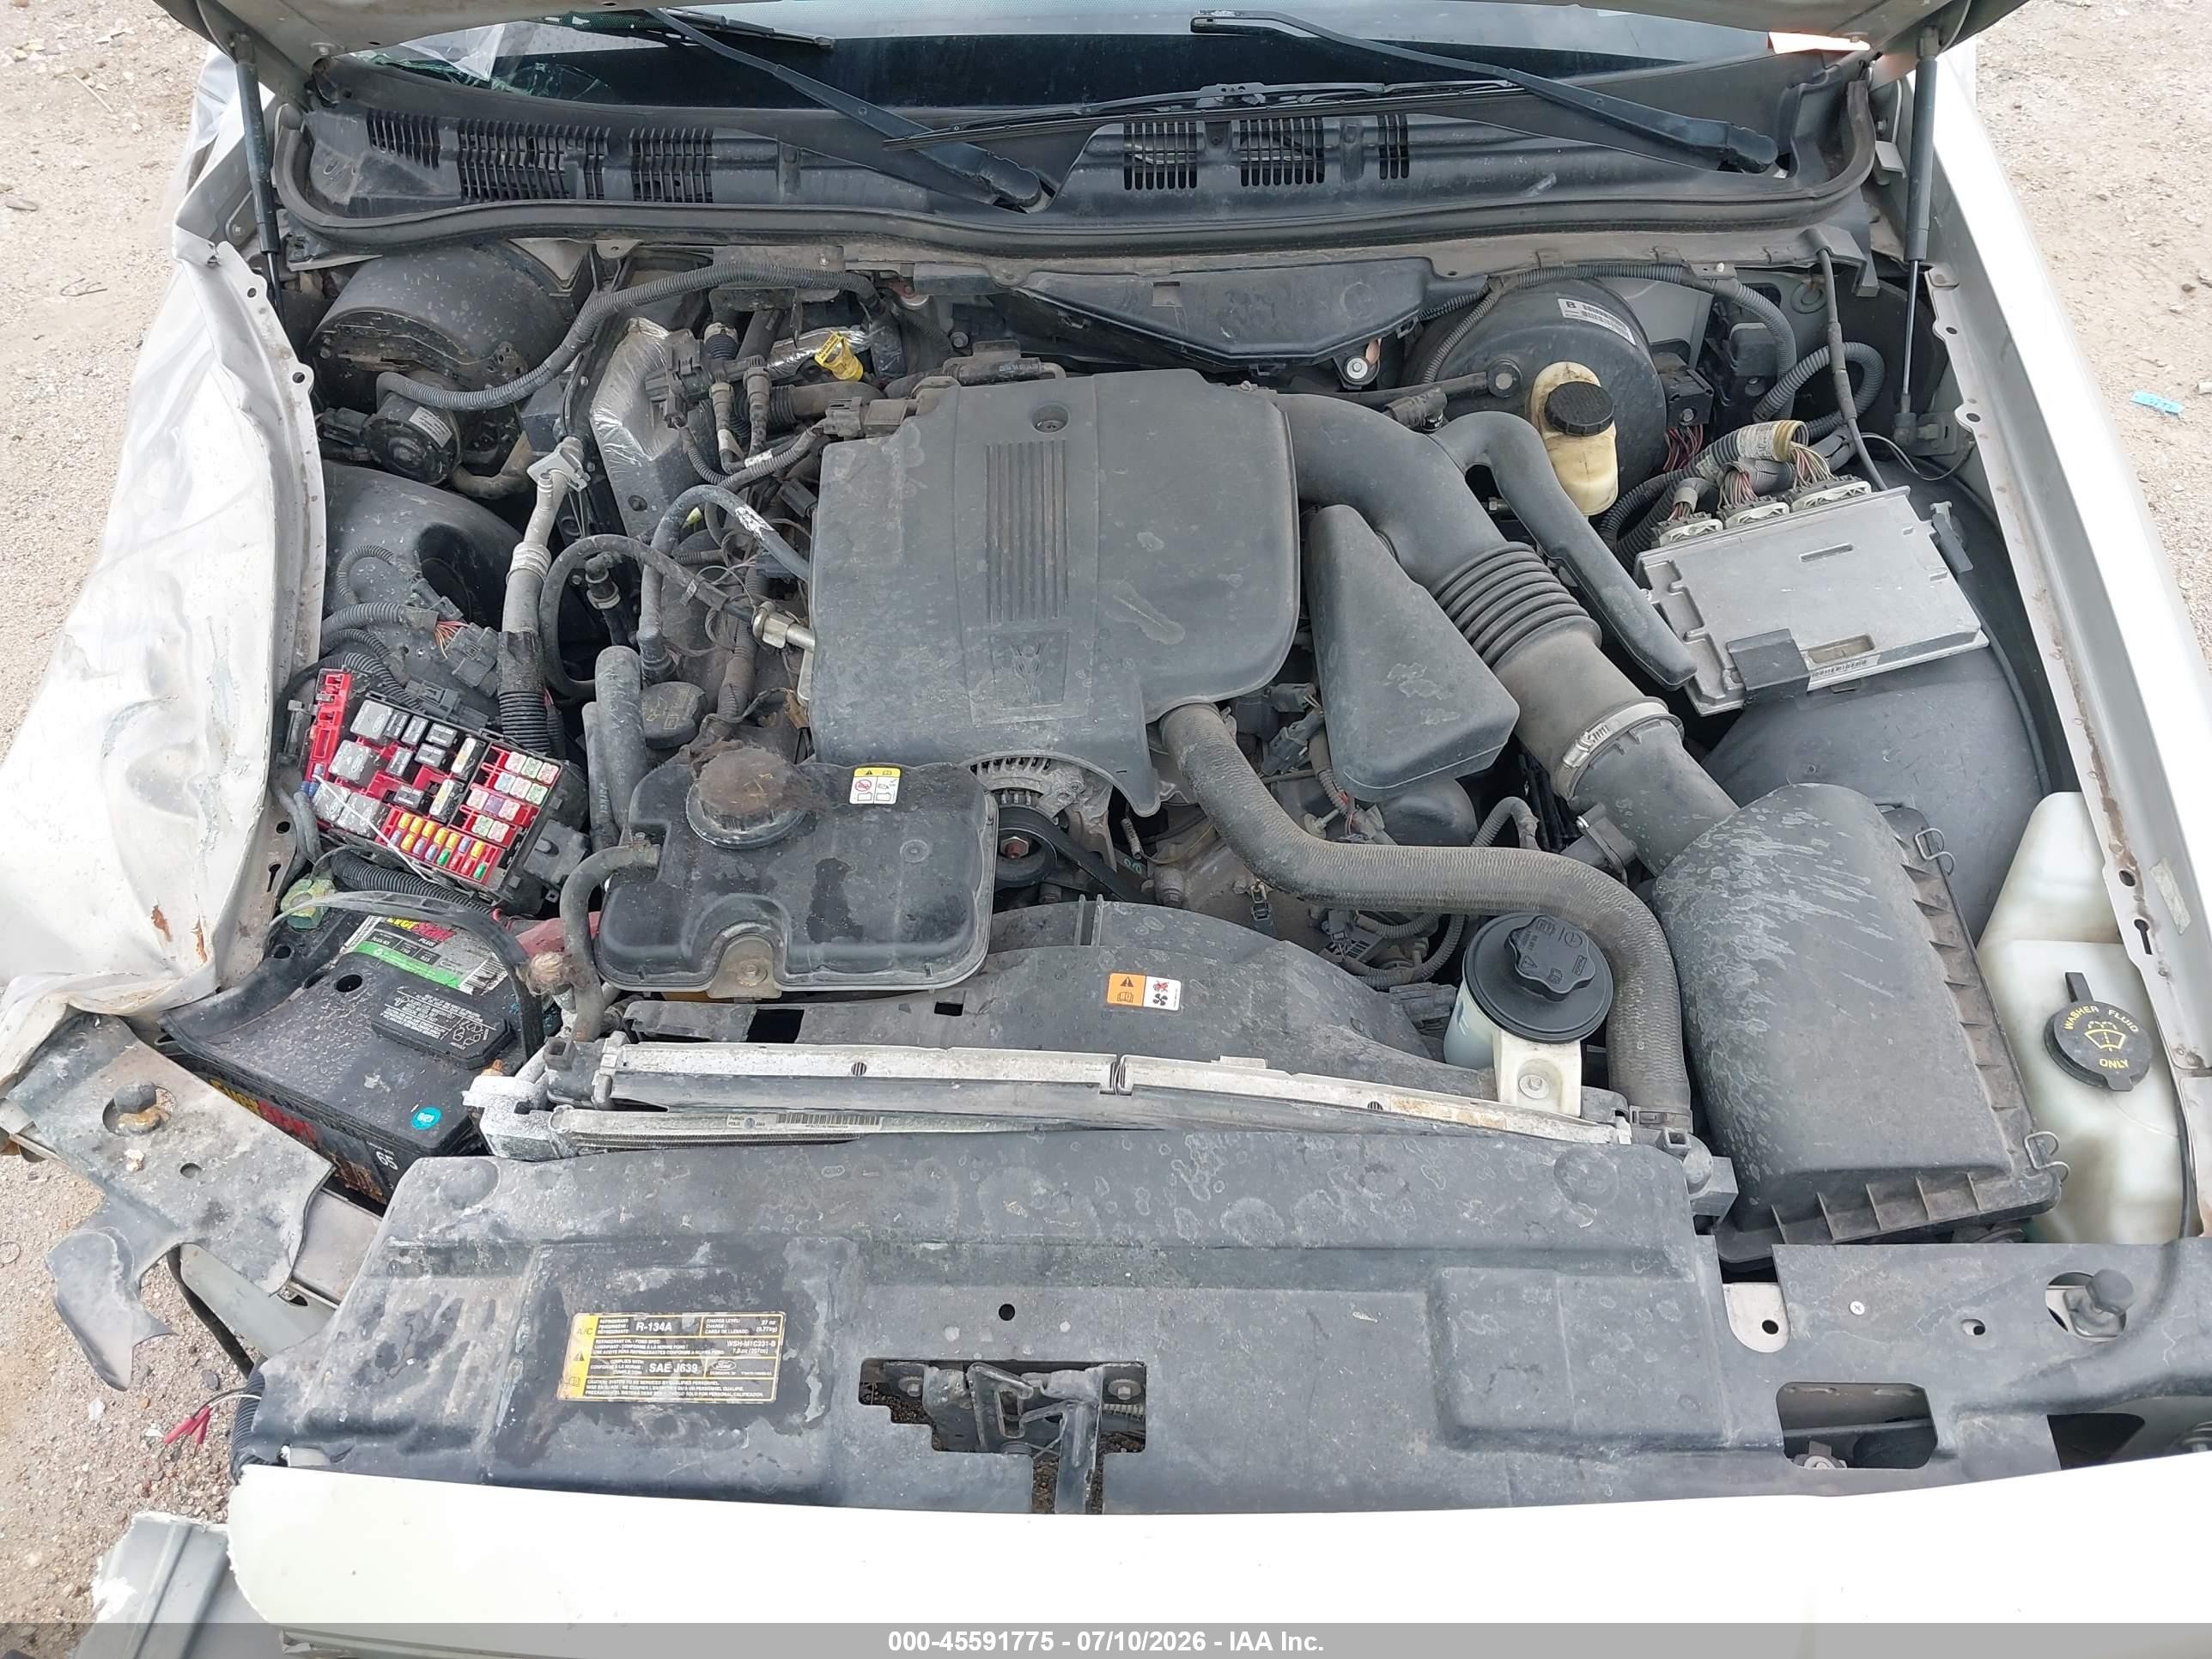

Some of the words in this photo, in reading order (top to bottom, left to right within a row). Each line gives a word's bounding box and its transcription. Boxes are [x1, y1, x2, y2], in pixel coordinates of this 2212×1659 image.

[2063, 1006, 2100, 1030] WASHER
[2108, 1009, 2139, 1033] FLUID
[2099, 1058, 2130, 1069] ONLY
[375, 1151, 398, 1170] 65
[635, 1322, 672, 1332] R-134A
[648, 1363, 671, 1373] SAE
[672, 1363, 698, 1373] J639
